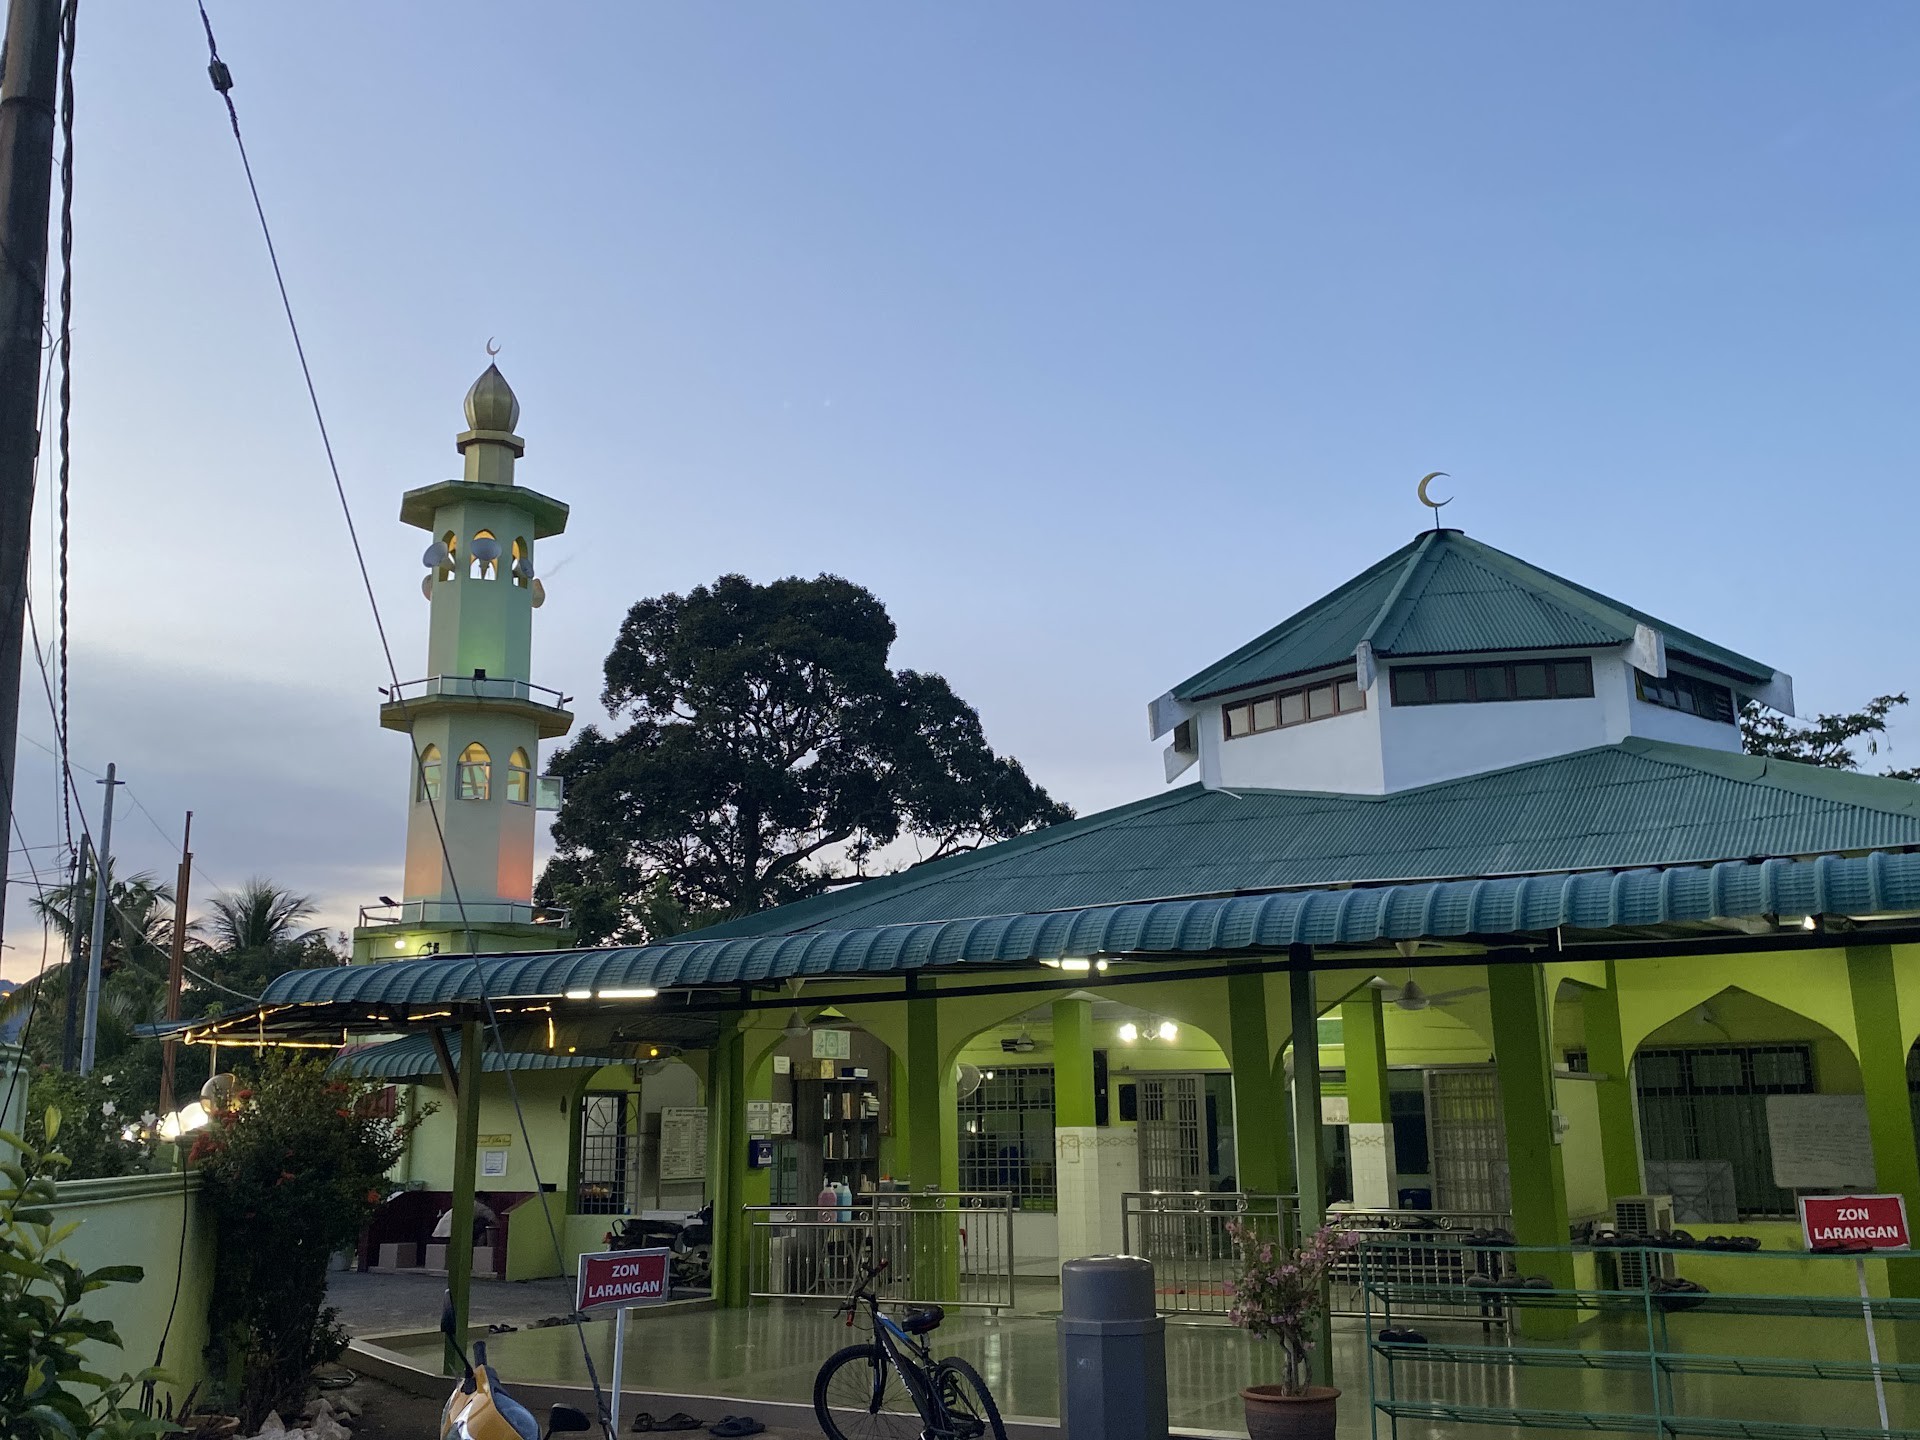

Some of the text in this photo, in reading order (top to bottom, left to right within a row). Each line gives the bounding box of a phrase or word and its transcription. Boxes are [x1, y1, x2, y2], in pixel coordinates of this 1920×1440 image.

[1837, 1208, 1869, 1221] ZON
[1814, 1226, 1898, 1239] LARANGAN
[612, 1264, 639, 1277] ZON
[589, 1281, 659, 1298] LARANGAN
